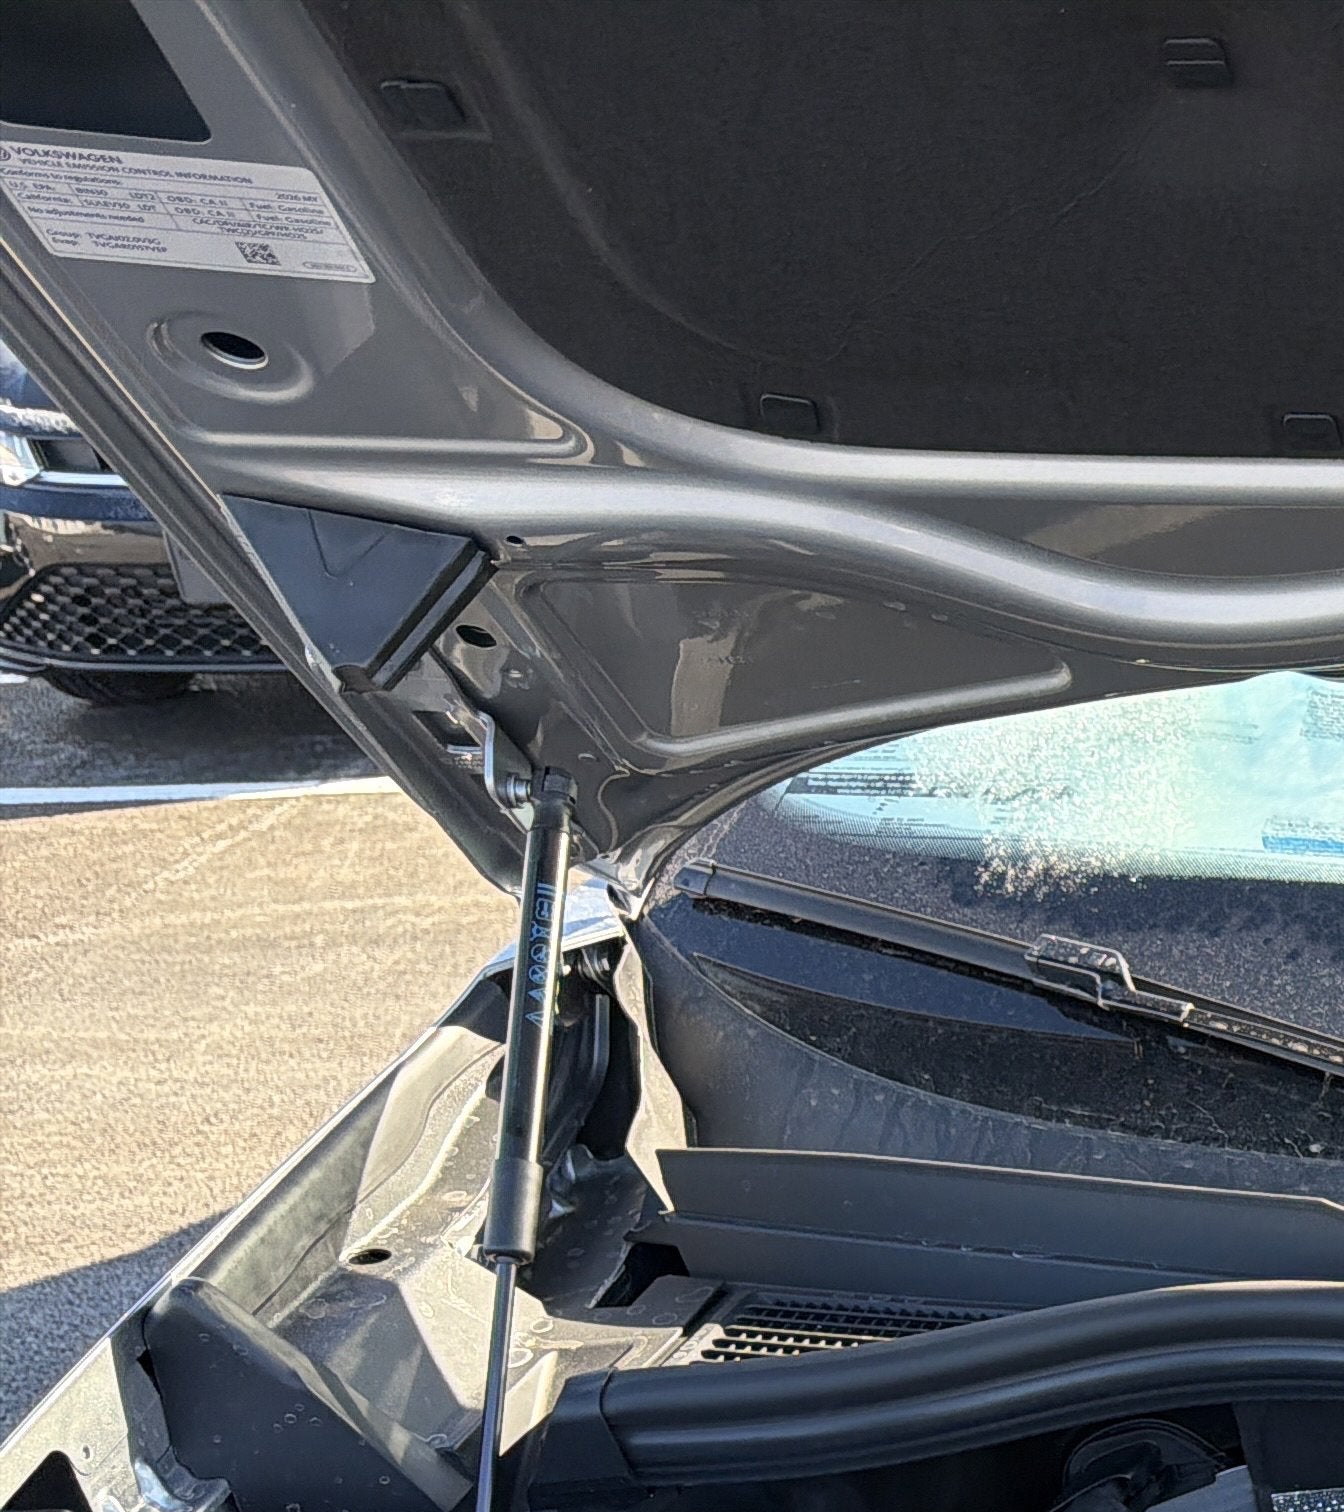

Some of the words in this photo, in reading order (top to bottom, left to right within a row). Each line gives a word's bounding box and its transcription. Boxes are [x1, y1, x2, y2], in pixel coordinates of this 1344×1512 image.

[10, 146, 123, 164] VOLKSWAGEN
[20, 158, 63, 168] VEHICLE
[65, 162, 120, 173] EMISSION
[122, 167, 174, 177] CONTROL
[175, 172, 252, 184] INFORMATION
